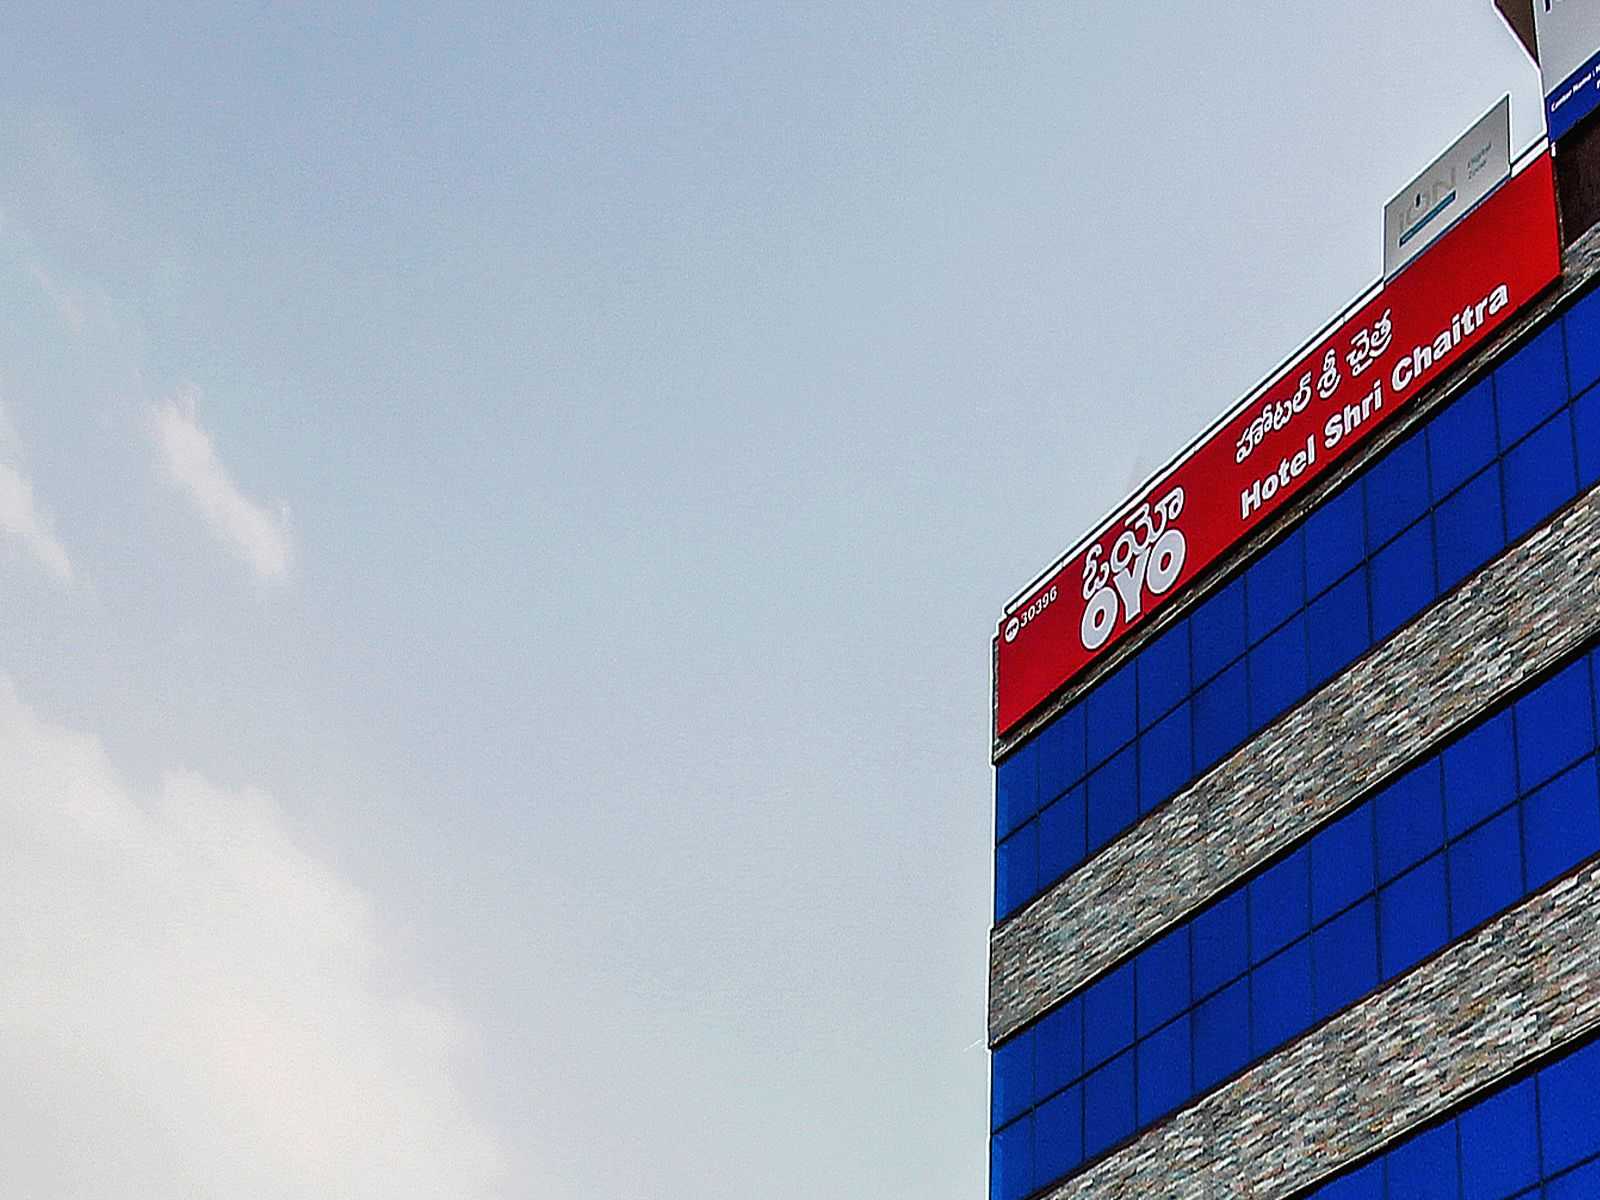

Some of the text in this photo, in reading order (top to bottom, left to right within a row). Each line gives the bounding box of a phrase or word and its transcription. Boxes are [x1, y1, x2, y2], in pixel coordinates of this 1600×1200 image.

[1240, 284, 1509, 520] Hotel Shri Chaitra
[1020, 585, 1058, 628] 30396
[1081, 528, 1187, 651] OYO
